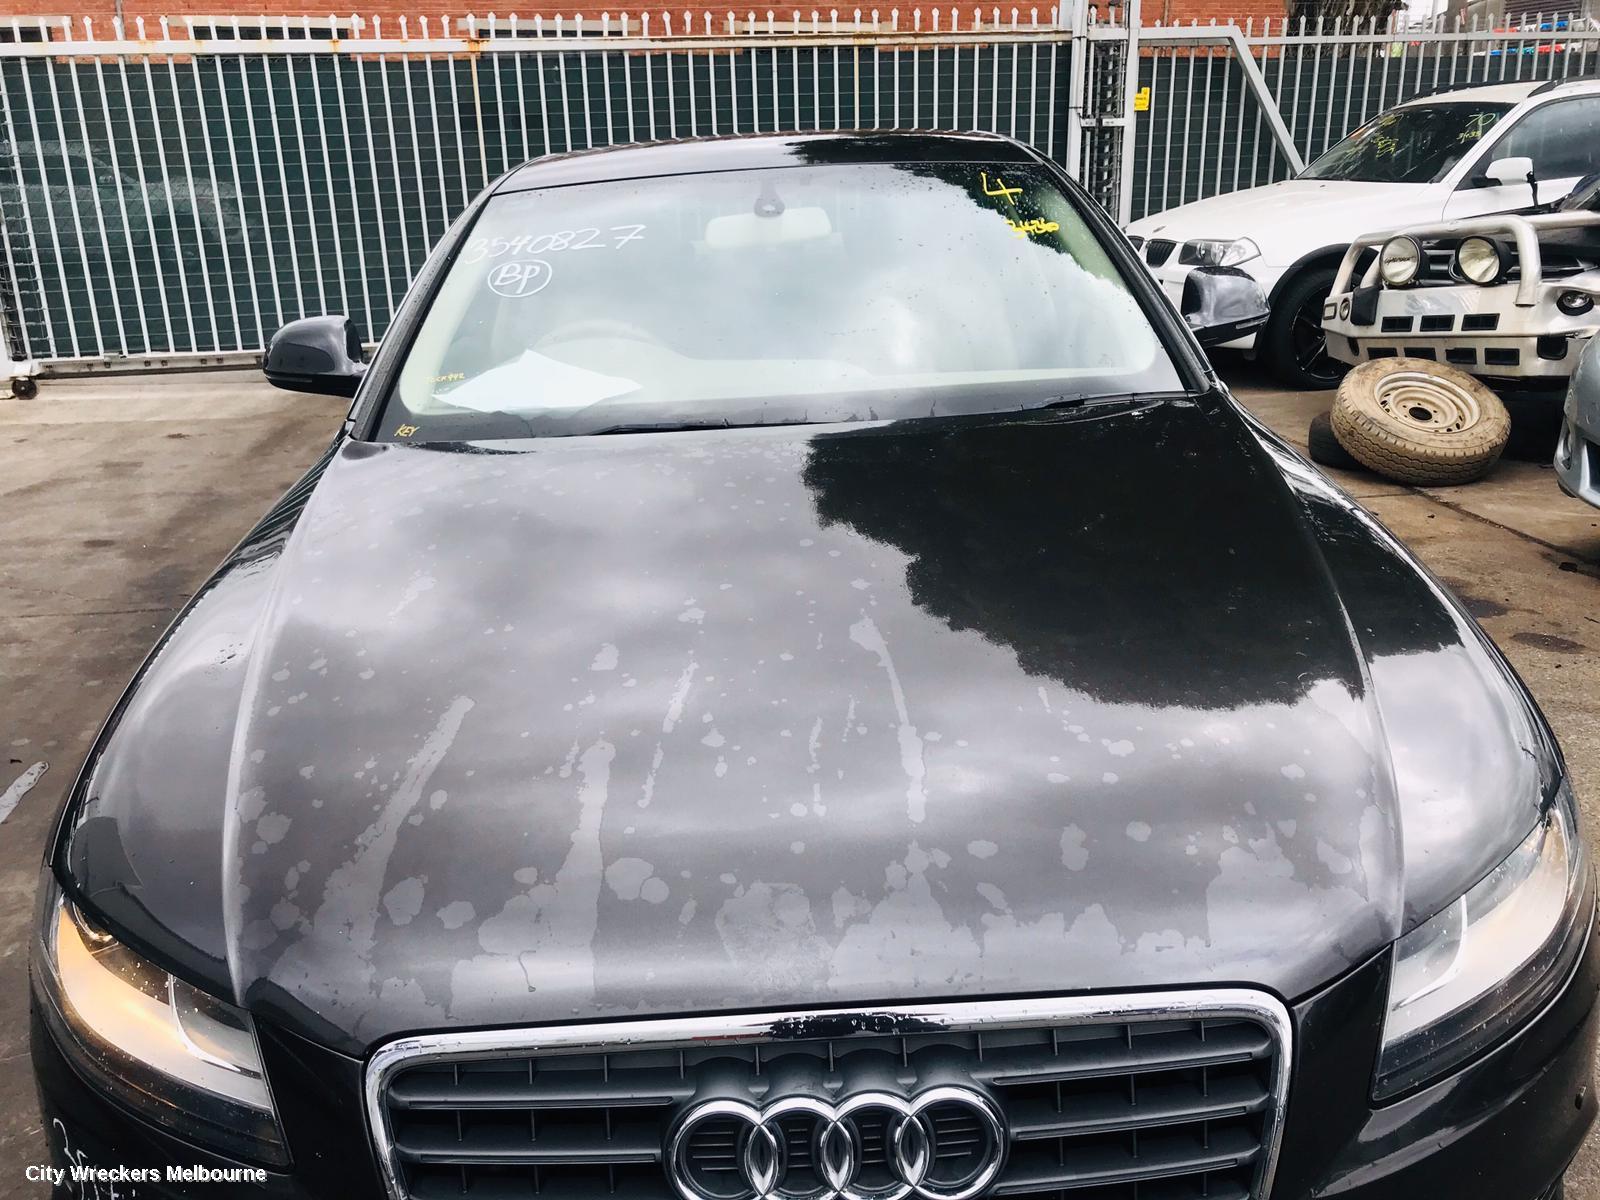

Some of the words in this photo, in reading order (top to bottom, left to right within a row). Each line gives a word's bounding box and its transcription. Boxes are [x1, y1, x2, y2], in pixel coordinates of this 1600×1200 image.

[980, 171, 1023, 205] 4
[494, 262, 540, 294] BP
[394, 423, 420, 437] KEY
